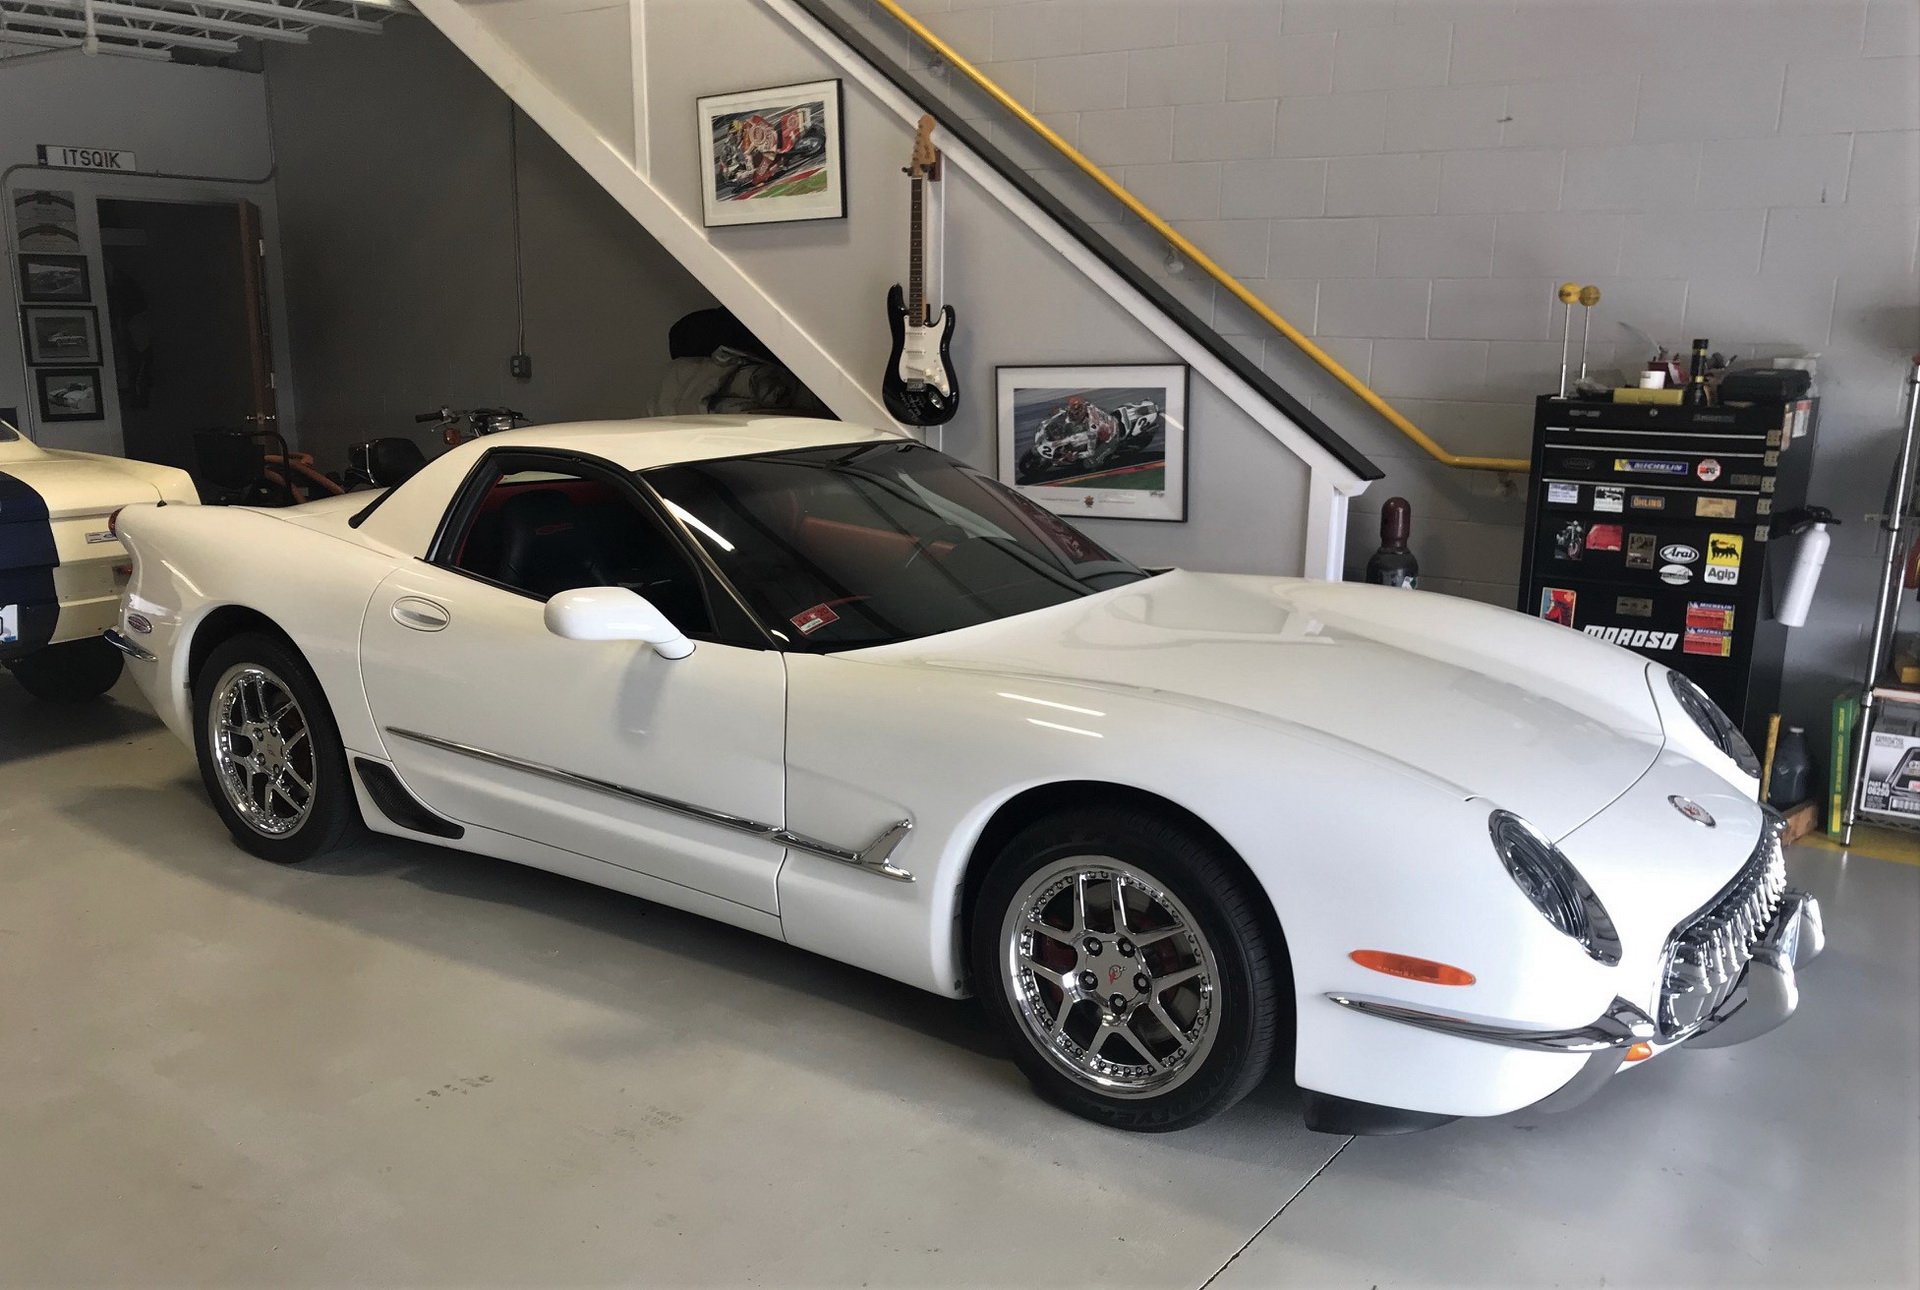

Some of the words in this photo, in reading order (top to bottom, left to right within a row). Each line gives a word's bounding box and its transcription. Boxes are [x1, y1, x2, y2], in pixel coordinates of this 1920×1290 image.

[63, 149, 120, 168] ITSQIK
[1634, 462, 1683, 471] MICHELIN
[1664, 547, 1693, 559] Arai
[1708, 567, 1736, 581] Agip
[1583, 625, 1679, 650] MOROSO
